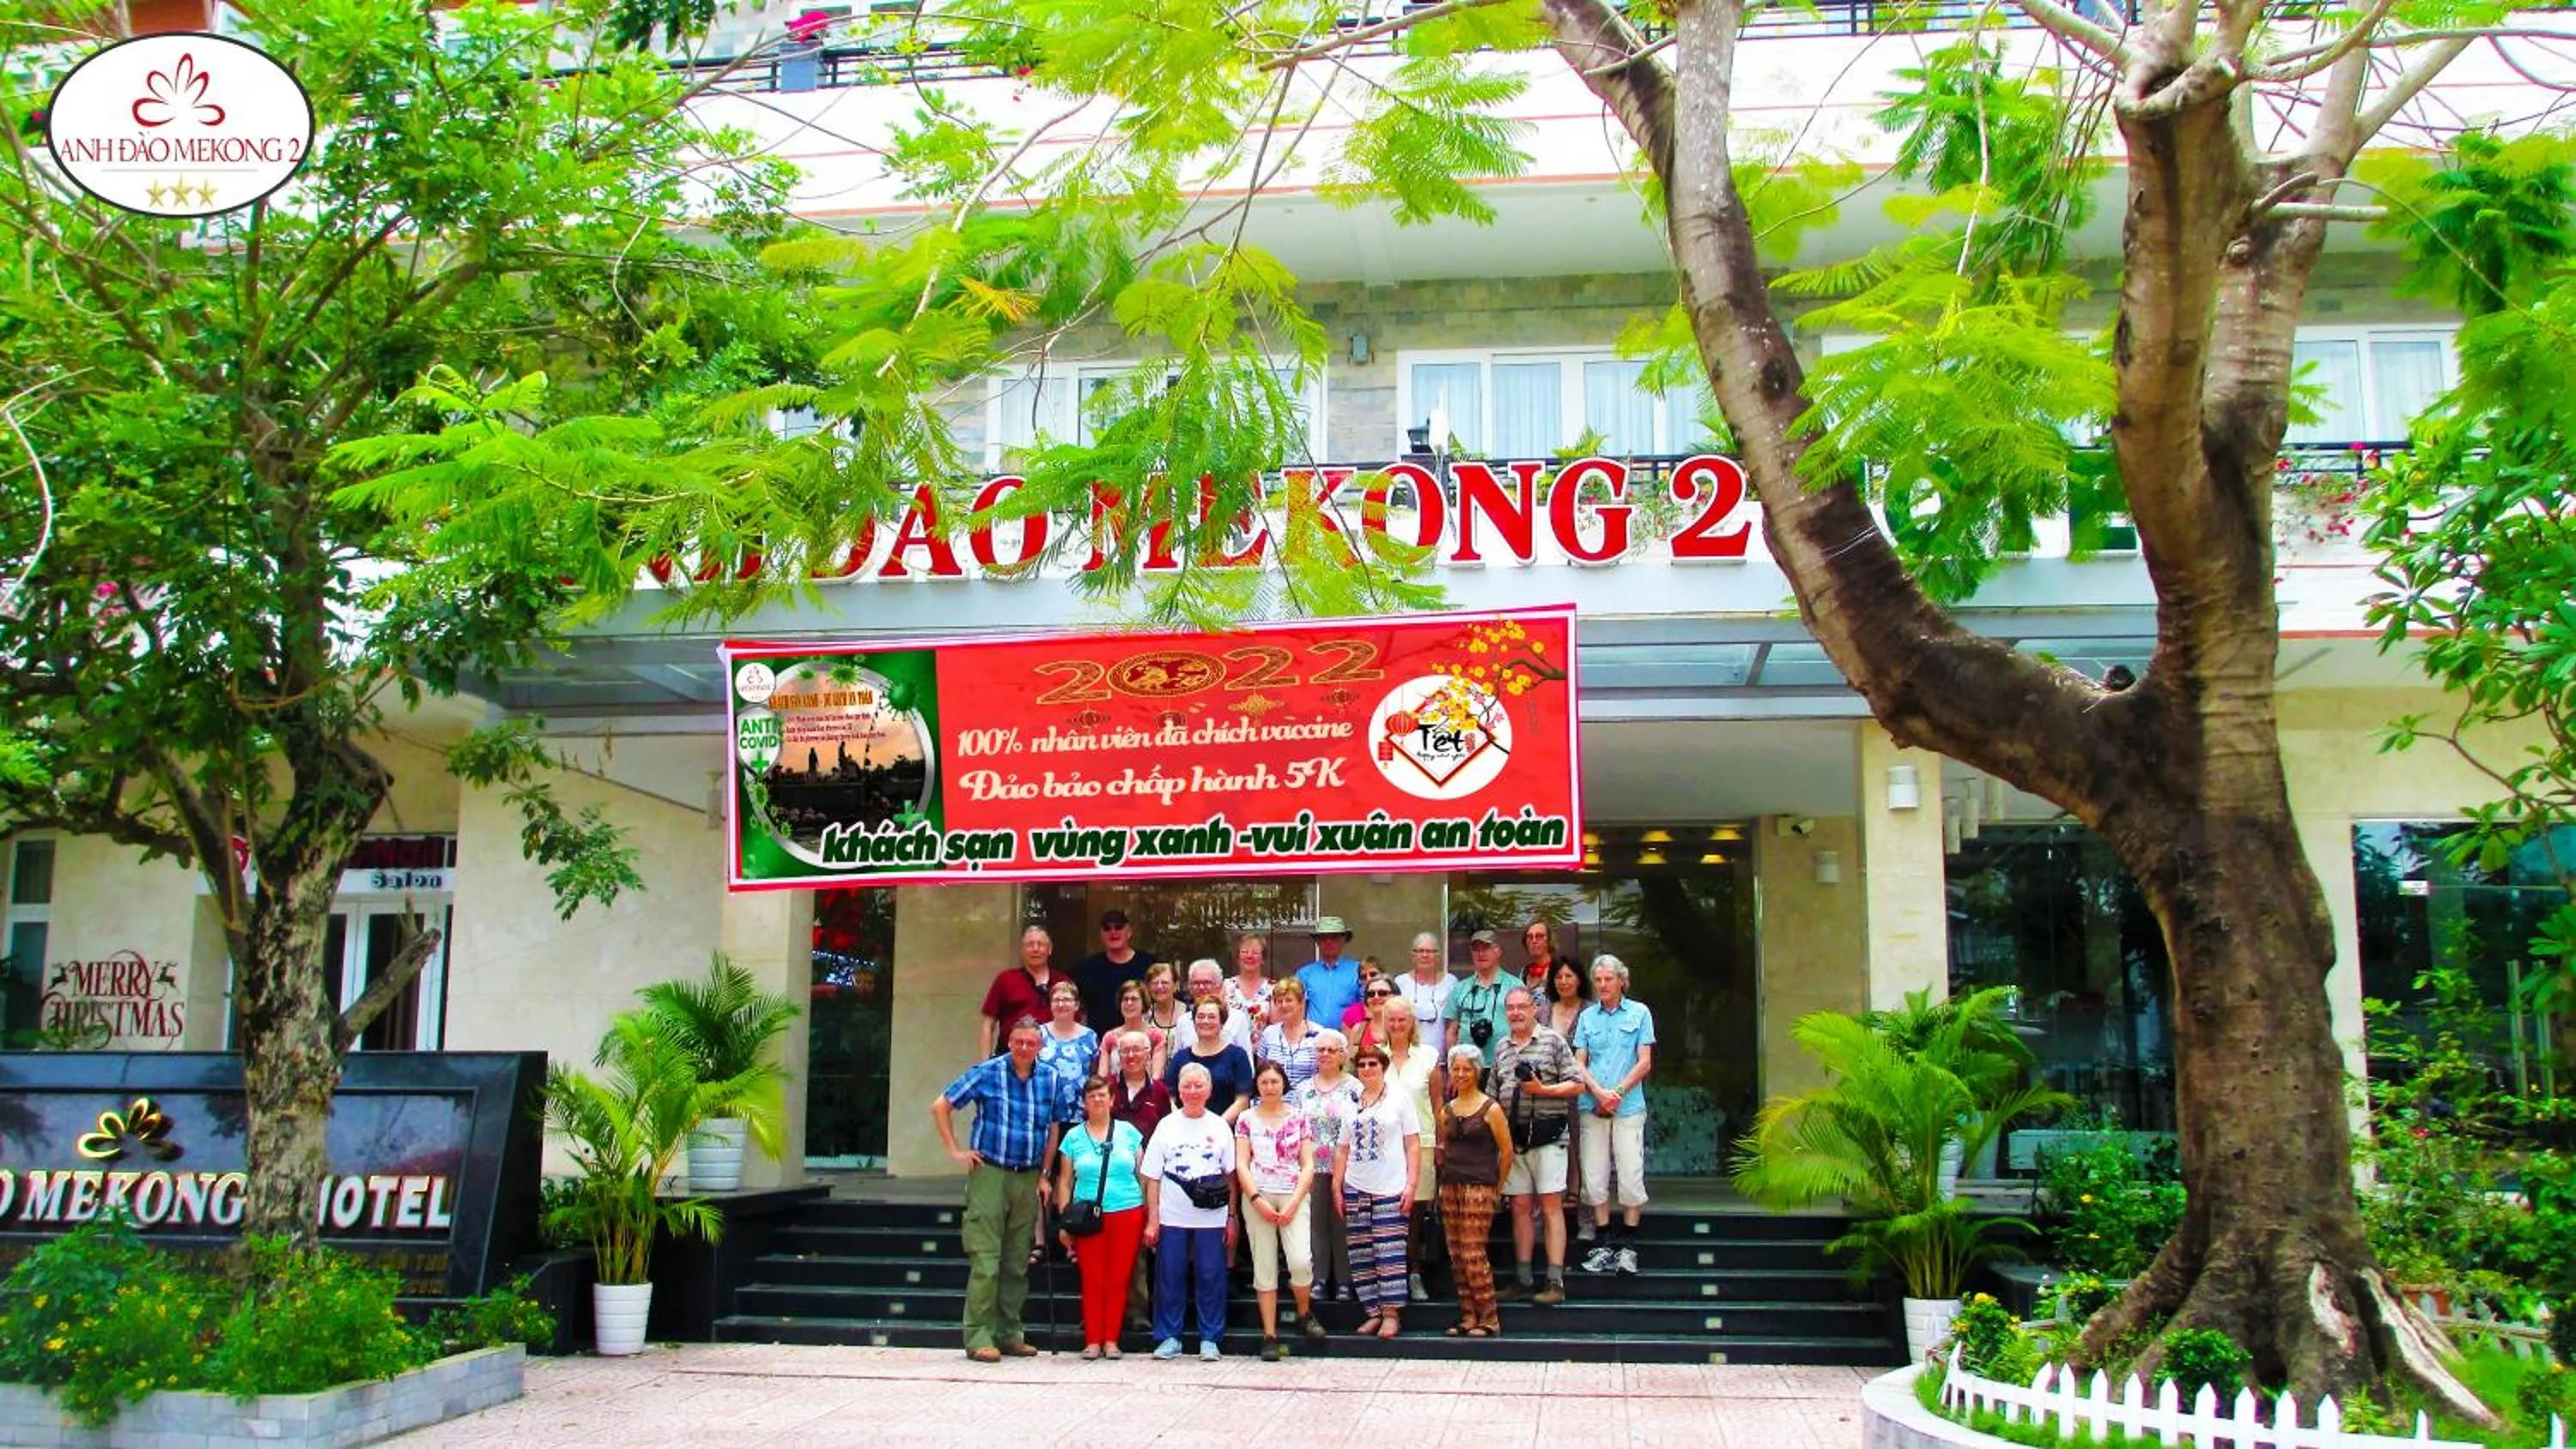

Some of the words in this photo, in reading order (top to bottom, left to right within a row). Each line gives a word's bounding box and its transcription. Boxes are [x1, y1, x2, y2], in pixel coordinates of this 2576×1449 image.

[1670, 456, 1753, 559] 2
[738, 735, 778, 750] COVID
[957, 727, 1023, 757] 100%
[1030, 725, 1099, 753] nhân
[1100, 725, 1153, 750] viên
[1155, 718, 1191, 747] đã
[1192, 715, 1260, 745] chích
[1260, 715, 1354, 742] vaccine
[958, 769, 1039, 801] Đảo
[1042, 771, 1103, 798] bảo
[1105, 764, 1186, 806] chấp
[1189, 763, 1279, 793] hành
[1284, 756, 1347, 789] 5K
[822, 822, 940, 863] khách
[944, 834, 1014, 871] sạn
[1031, 818, 1127, 864] vùng
[1133, 816, 1230, 857] xanh
[1314, 814, 1413, 850] xuân
[1421, 821, 1471, 849] an
[1478, 808, 1564, 848] toàn
[371, 870, 443, 889] Salon
[67, 951, 164, 1000] MERRY
[19, 1170, 248, 1226] MEKONG
